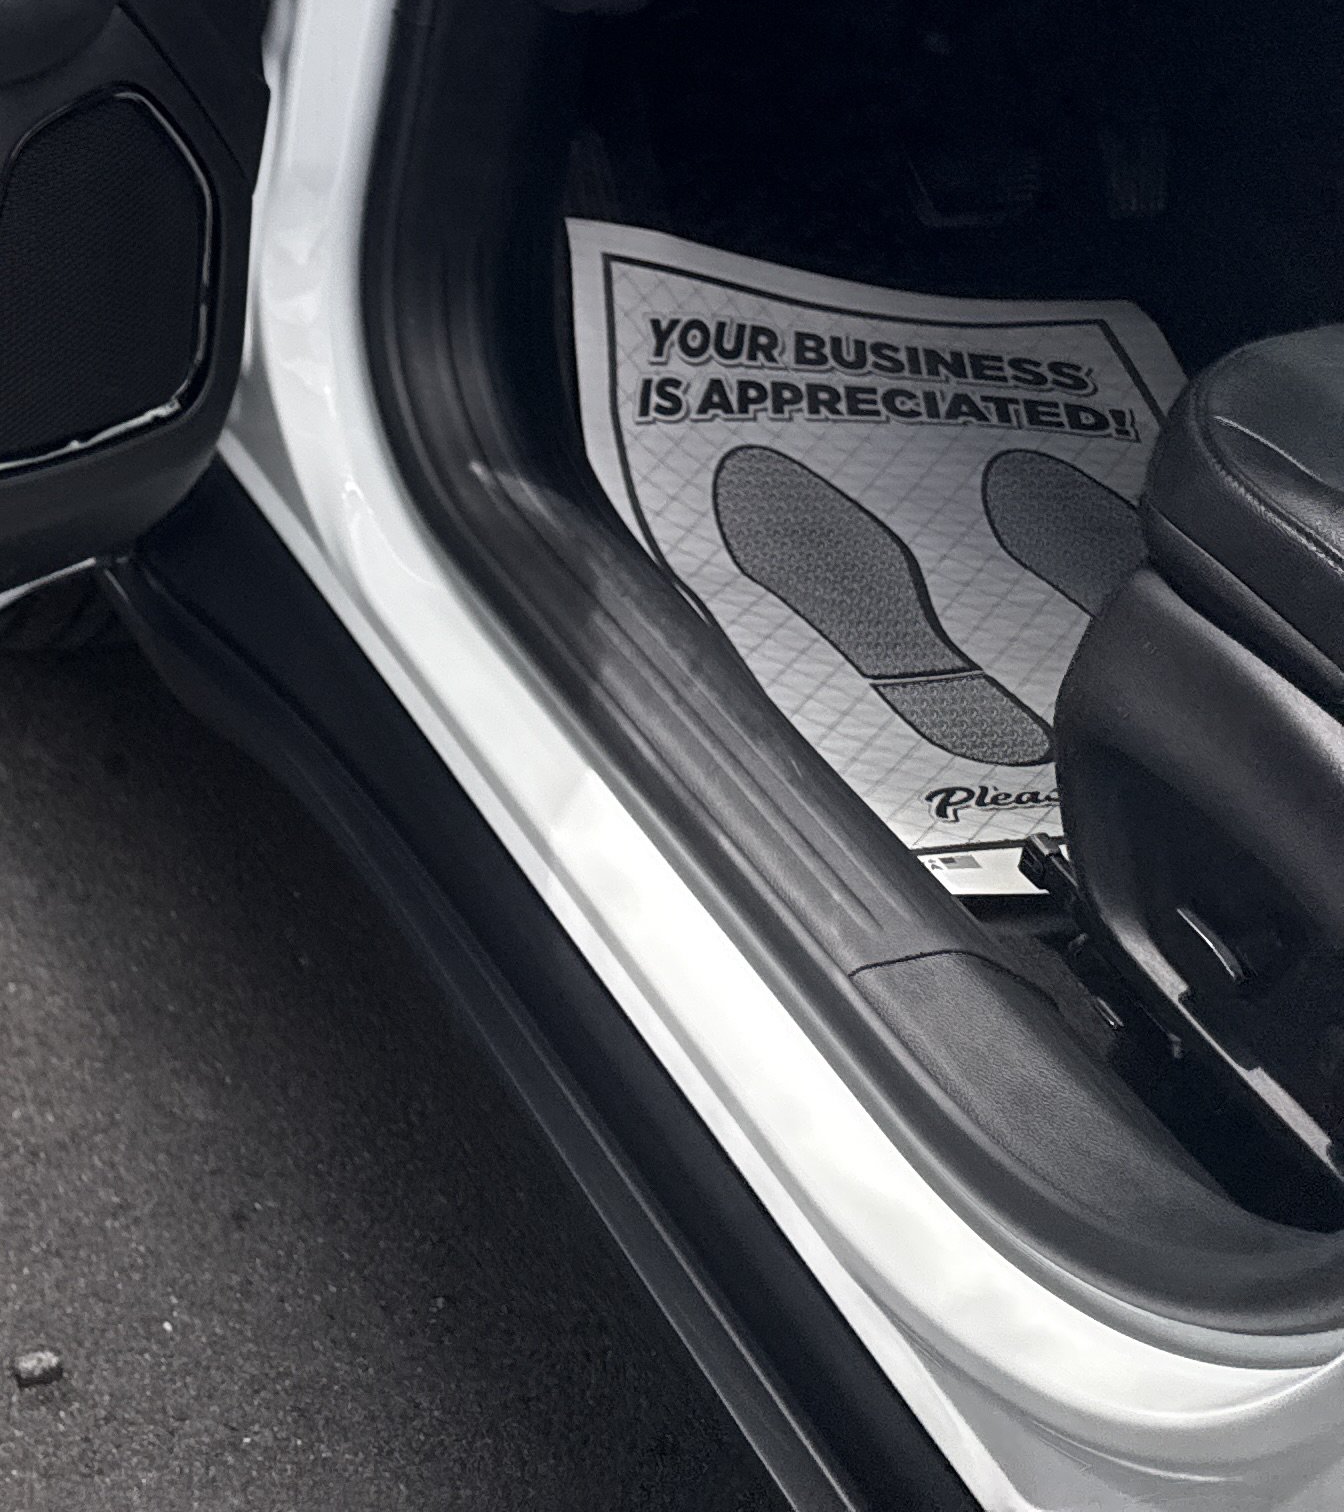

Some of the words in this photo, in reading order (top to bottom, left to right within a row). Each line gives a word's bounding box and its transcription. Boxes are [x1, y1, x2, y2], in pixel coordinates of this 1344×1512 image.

[648, 317, 782, 367] YOUR
[793, 330, 1093, 394] BUSINESS
[637, 377, 685, 420] IS
[695, 377, 1136, 439] APPRECIATED!
